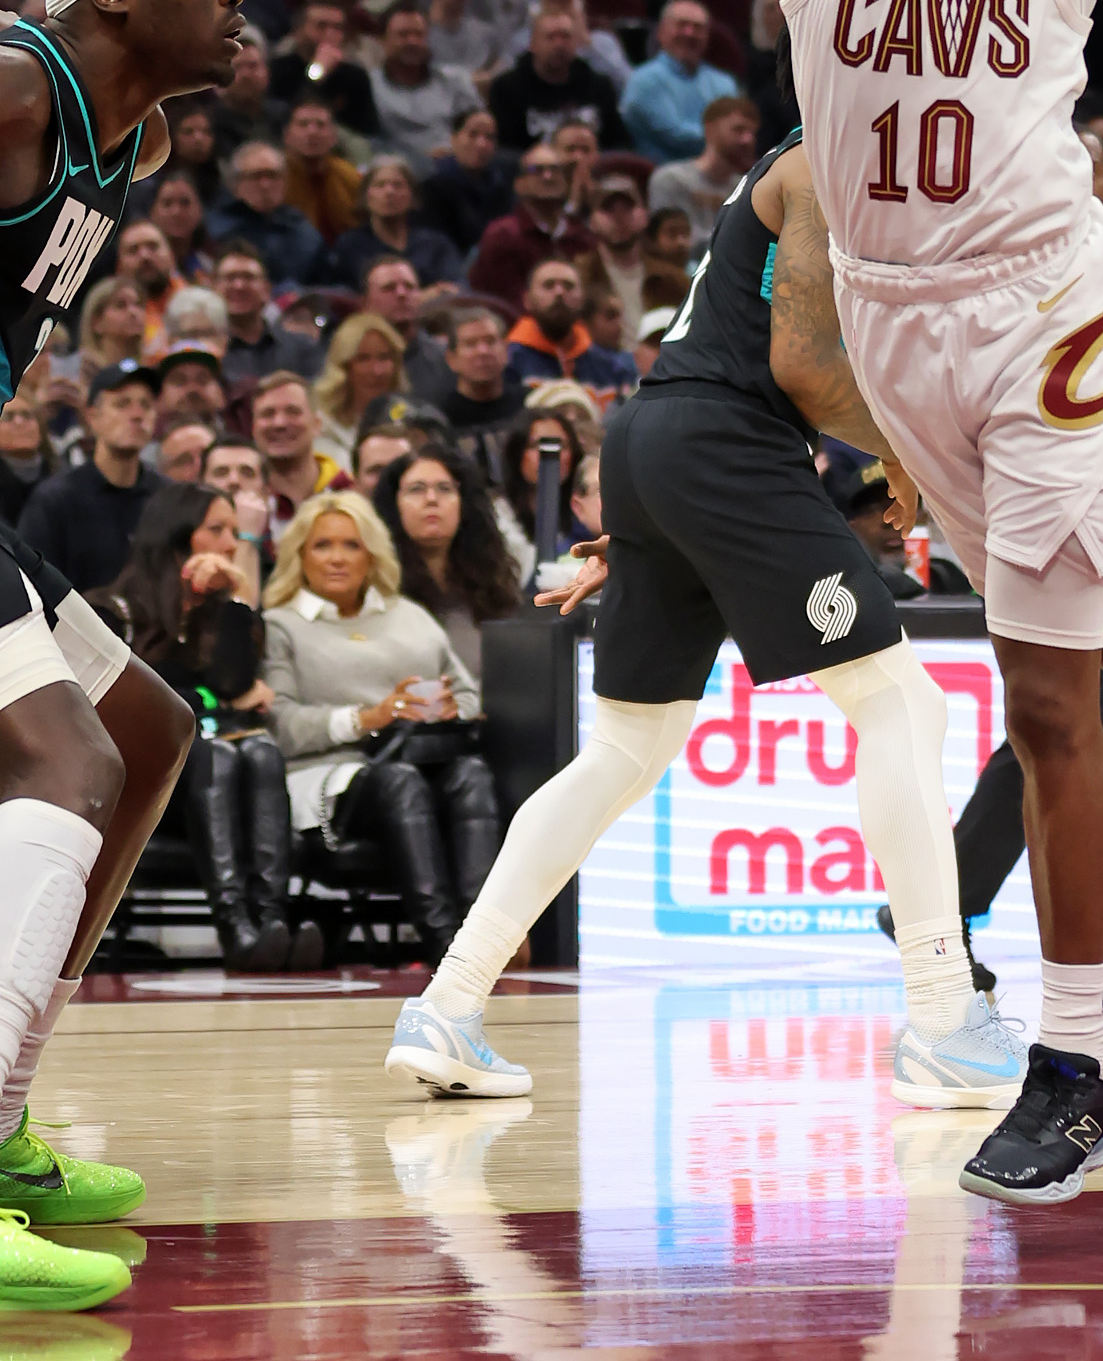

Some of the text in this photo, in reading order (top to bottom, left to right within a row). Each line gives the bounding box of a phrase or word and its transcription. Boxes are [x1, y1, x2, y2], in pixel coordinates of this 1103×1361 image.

[867, 99, 975, 204] 10
[686, 664, 859, 786] dru
[709, 826, 886, 896] ma
[729, 908, 882, 933] FOOD MAR
